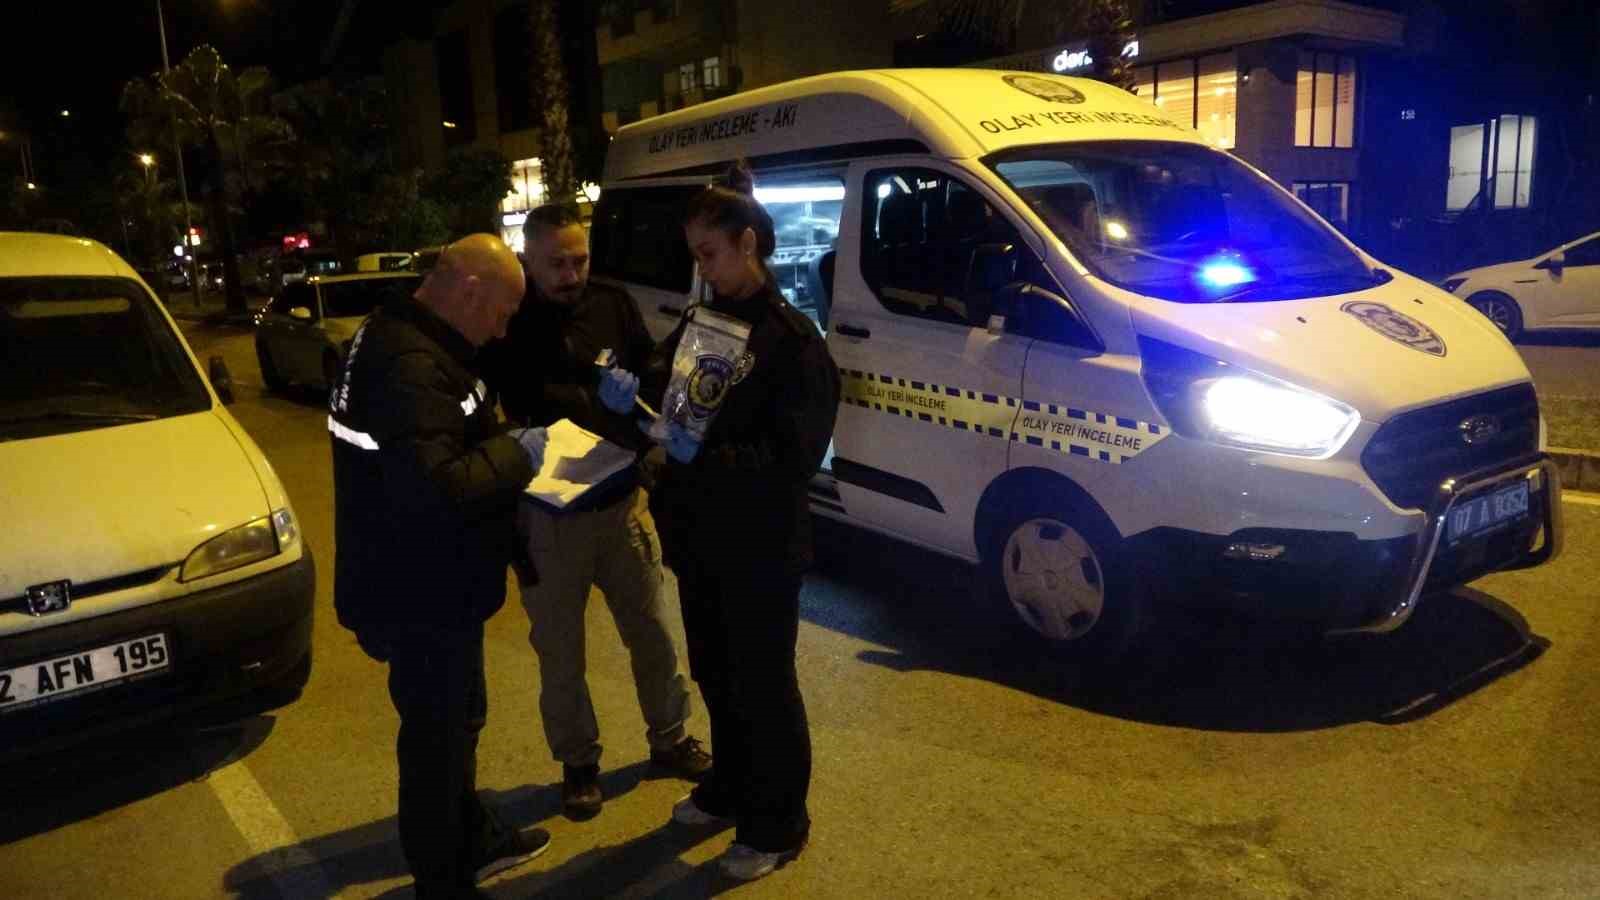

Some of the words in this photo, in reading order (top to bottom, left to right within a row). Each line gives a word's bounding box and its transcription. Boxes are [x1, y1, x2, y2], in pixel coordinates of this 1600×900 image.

[979, 113, 1041, 134] OLAY
[1040, 111, 1088, 125] YERİ
[649, 132, 674, 154] OLAY
[866, 383, 885, 398] OLAY
[887, 389, 905, 402] YERİ
[905, 391, 946, 410] İNCELEME
[1023, 415, 1049, 431] OLAY
[1051, 420, 1075, 437] YERİ
[1076, 423, 1142, 450] İNCELEME
[37, 654, 95, 695] AFN
[113, 637, 166, 673] 195
